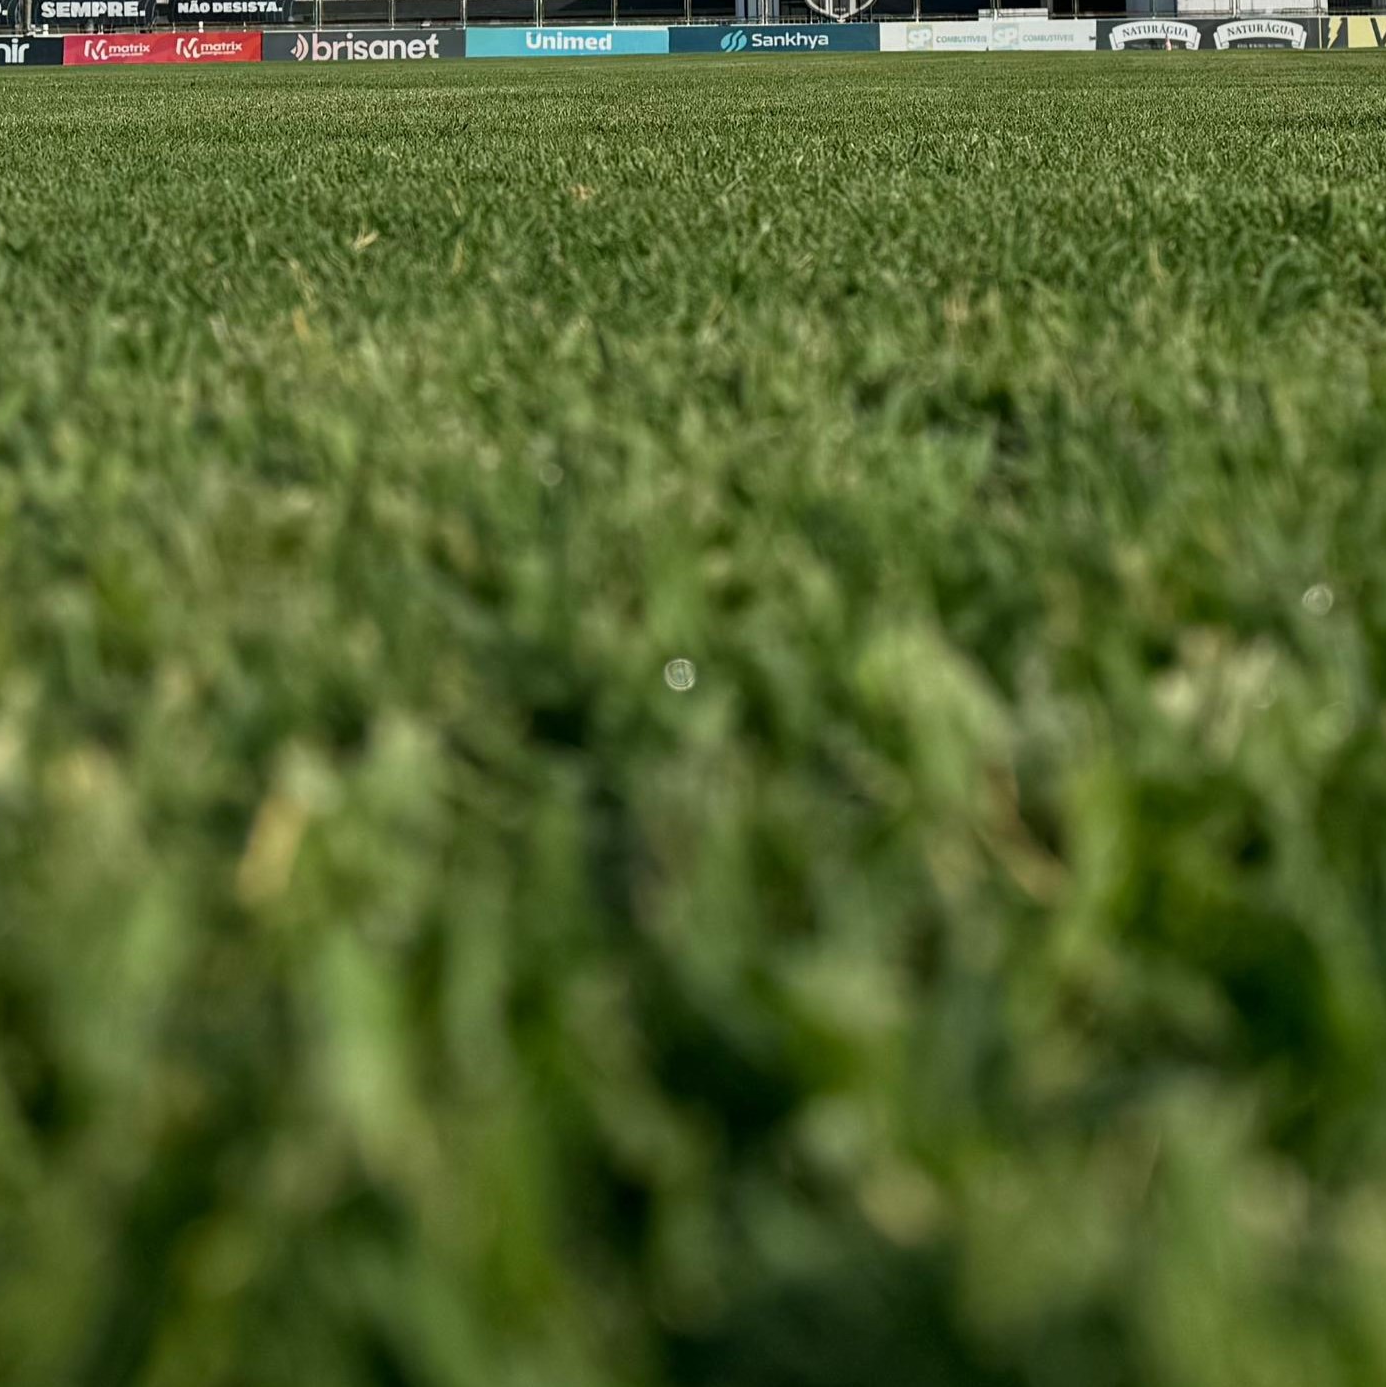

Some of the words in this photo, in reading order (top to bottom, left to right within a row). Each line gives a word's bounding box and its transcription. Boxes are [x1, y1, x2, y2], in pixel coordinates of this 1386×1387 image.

[40, 0, 145, 18] SEMPRE.
[178, 0, 208, 14] NÃO
[210, 0, 283, 13] DESISTA.
[1122, 23, 1188, 38] NATURÁGUA
[1227, 21, 1294, 37] NATURÁGUA
[109, 43, 150, 53] matrix
[201, 41, 242, 51] matrix
[313, 33, 439, 61] brisanet
[525, 31, 612, 51] Unimed
[751, 31, 830, 49] Sankhya
